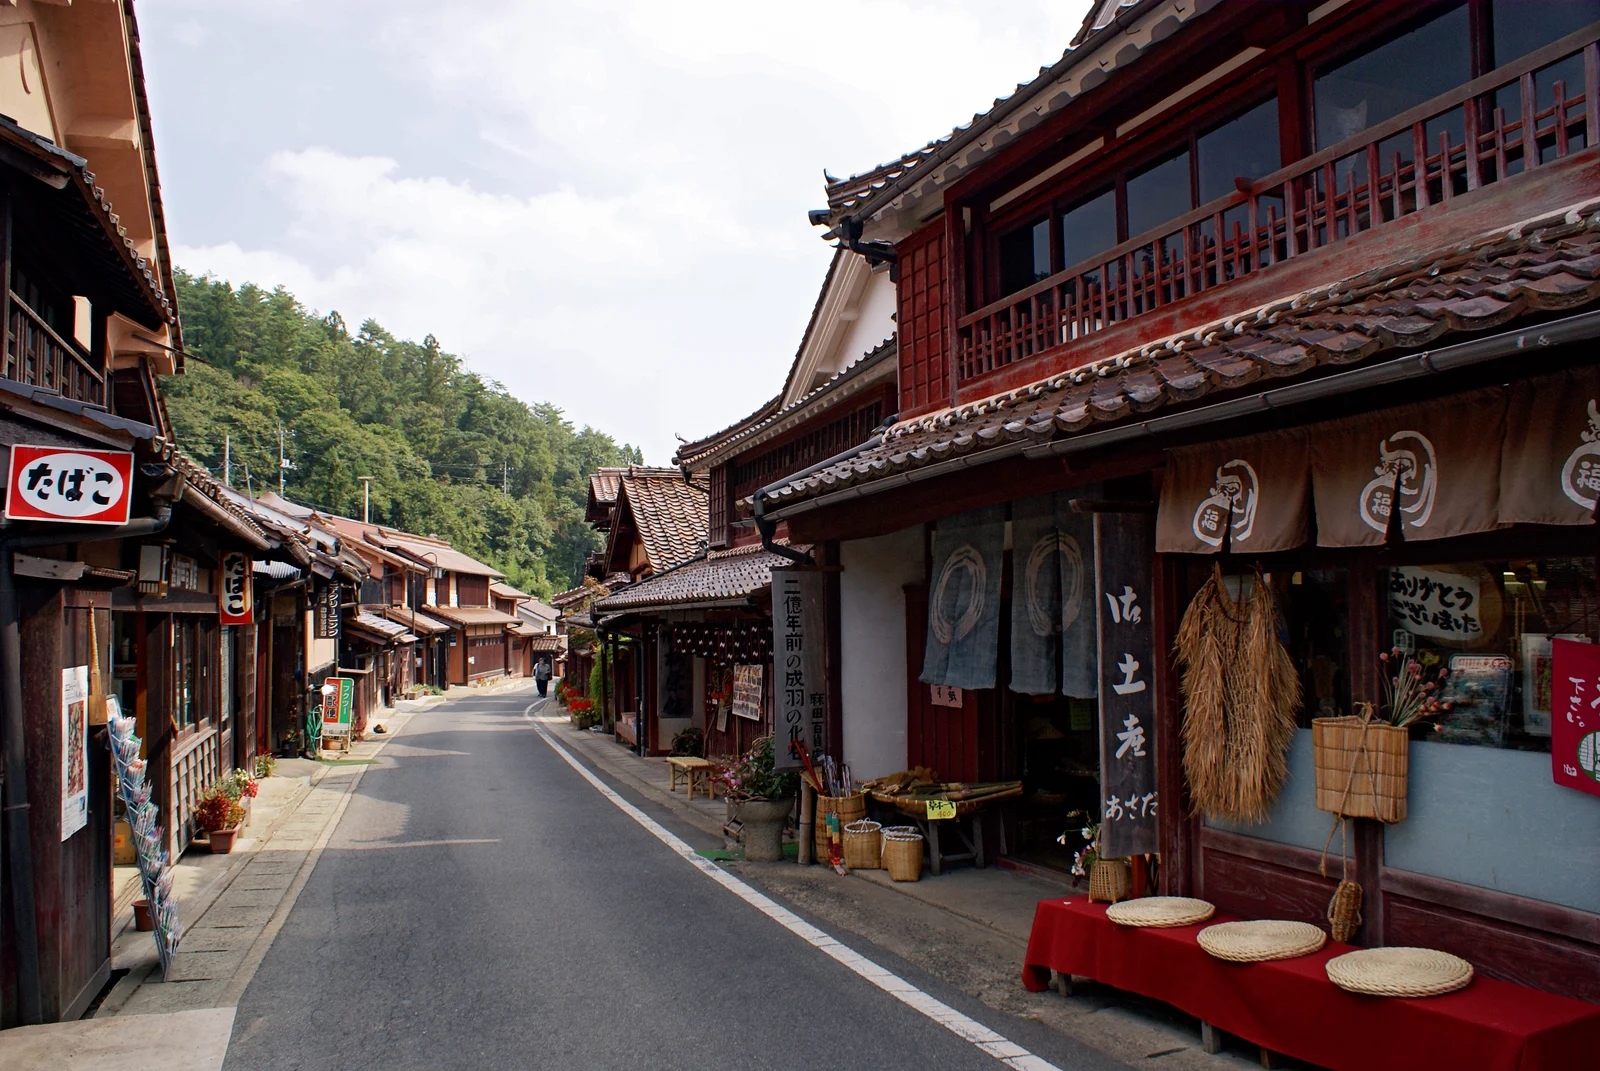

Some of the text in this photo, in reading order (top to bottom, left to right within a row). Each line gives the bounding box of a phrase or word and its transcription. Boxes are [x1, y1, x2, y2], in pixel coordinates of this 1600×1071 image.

[27, 463, 113, 505] たばこ
[1576, 461, 1600, 491] 福
[1201, 508, 1219, 531] 福
[1371, 491, 1391, 517] 福
[224, 554, 248, 614] たばこ
[1390, 569, 1474, 611] ありがとう
[1391, 600, 1482, 633] ございました
[1105, 791, 1158, 821] あさだ
